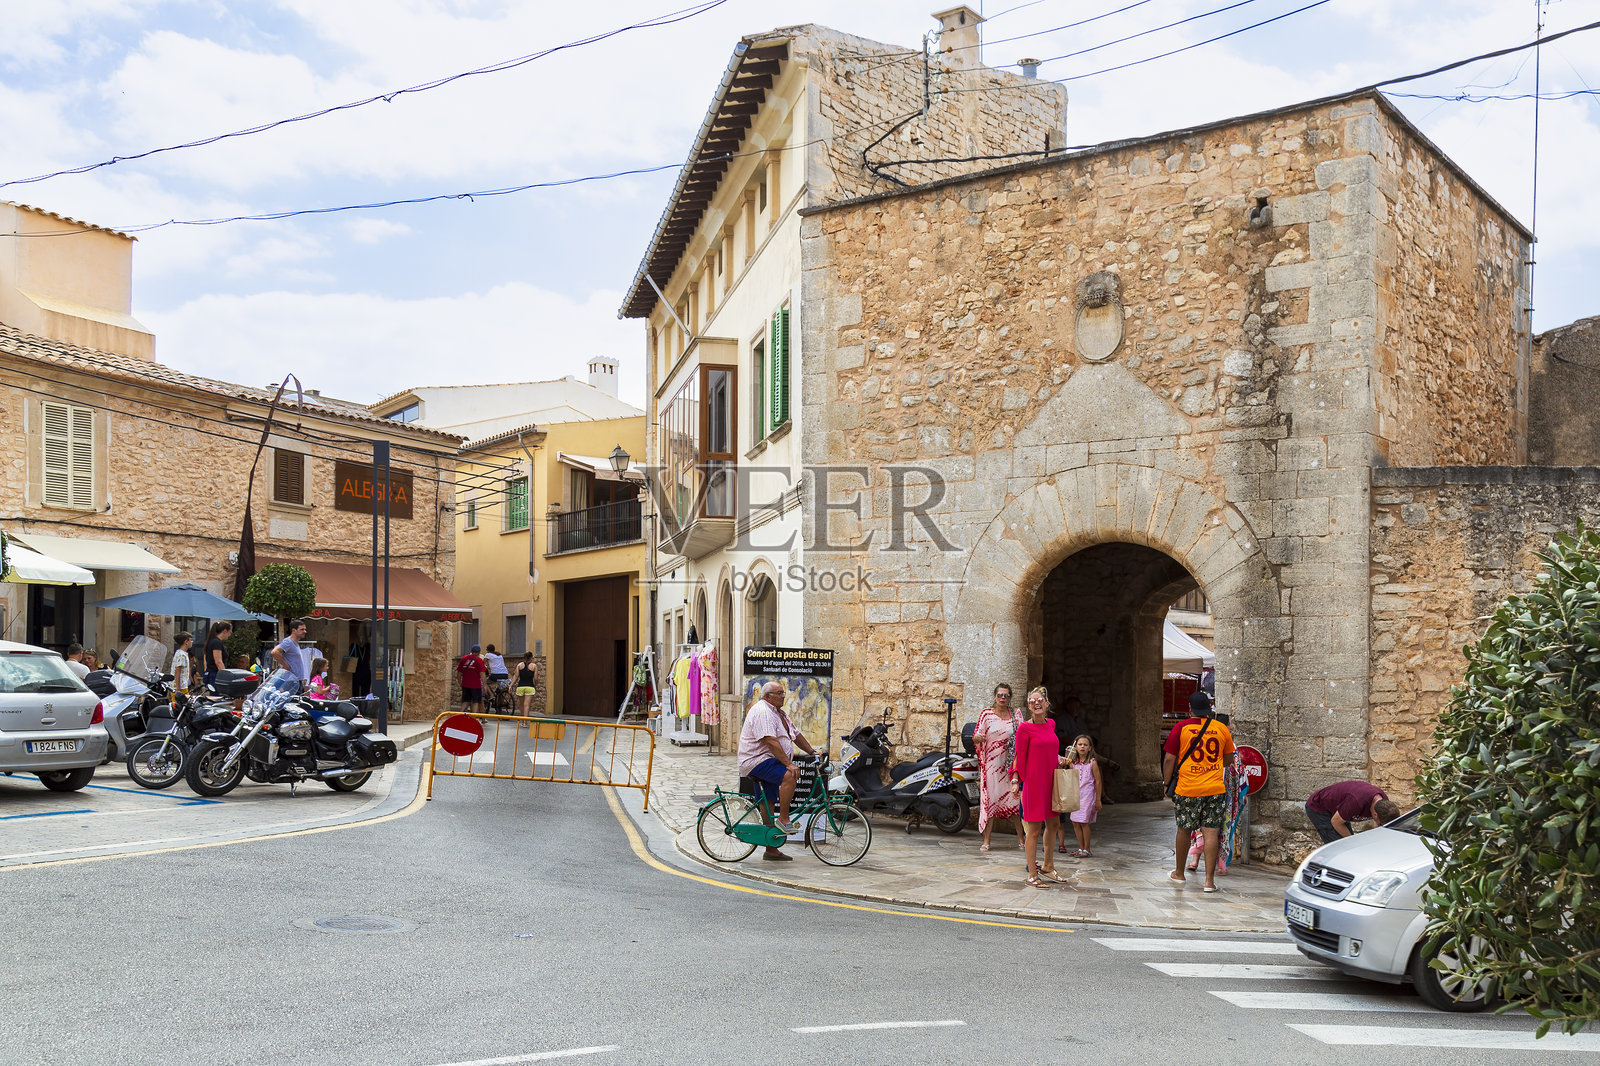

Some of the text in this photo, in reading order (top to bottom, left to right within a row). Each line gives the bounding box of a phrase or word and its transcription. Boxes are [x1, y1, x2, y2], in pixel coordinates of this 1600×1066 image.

[747, 649, 777, 658] Concert
[783, 650, 807, 660] posta
[808, 650, 818, 659] de
[819, 651, 831, 660] sol
[34, 741, 75, 752] 1824 FNS
